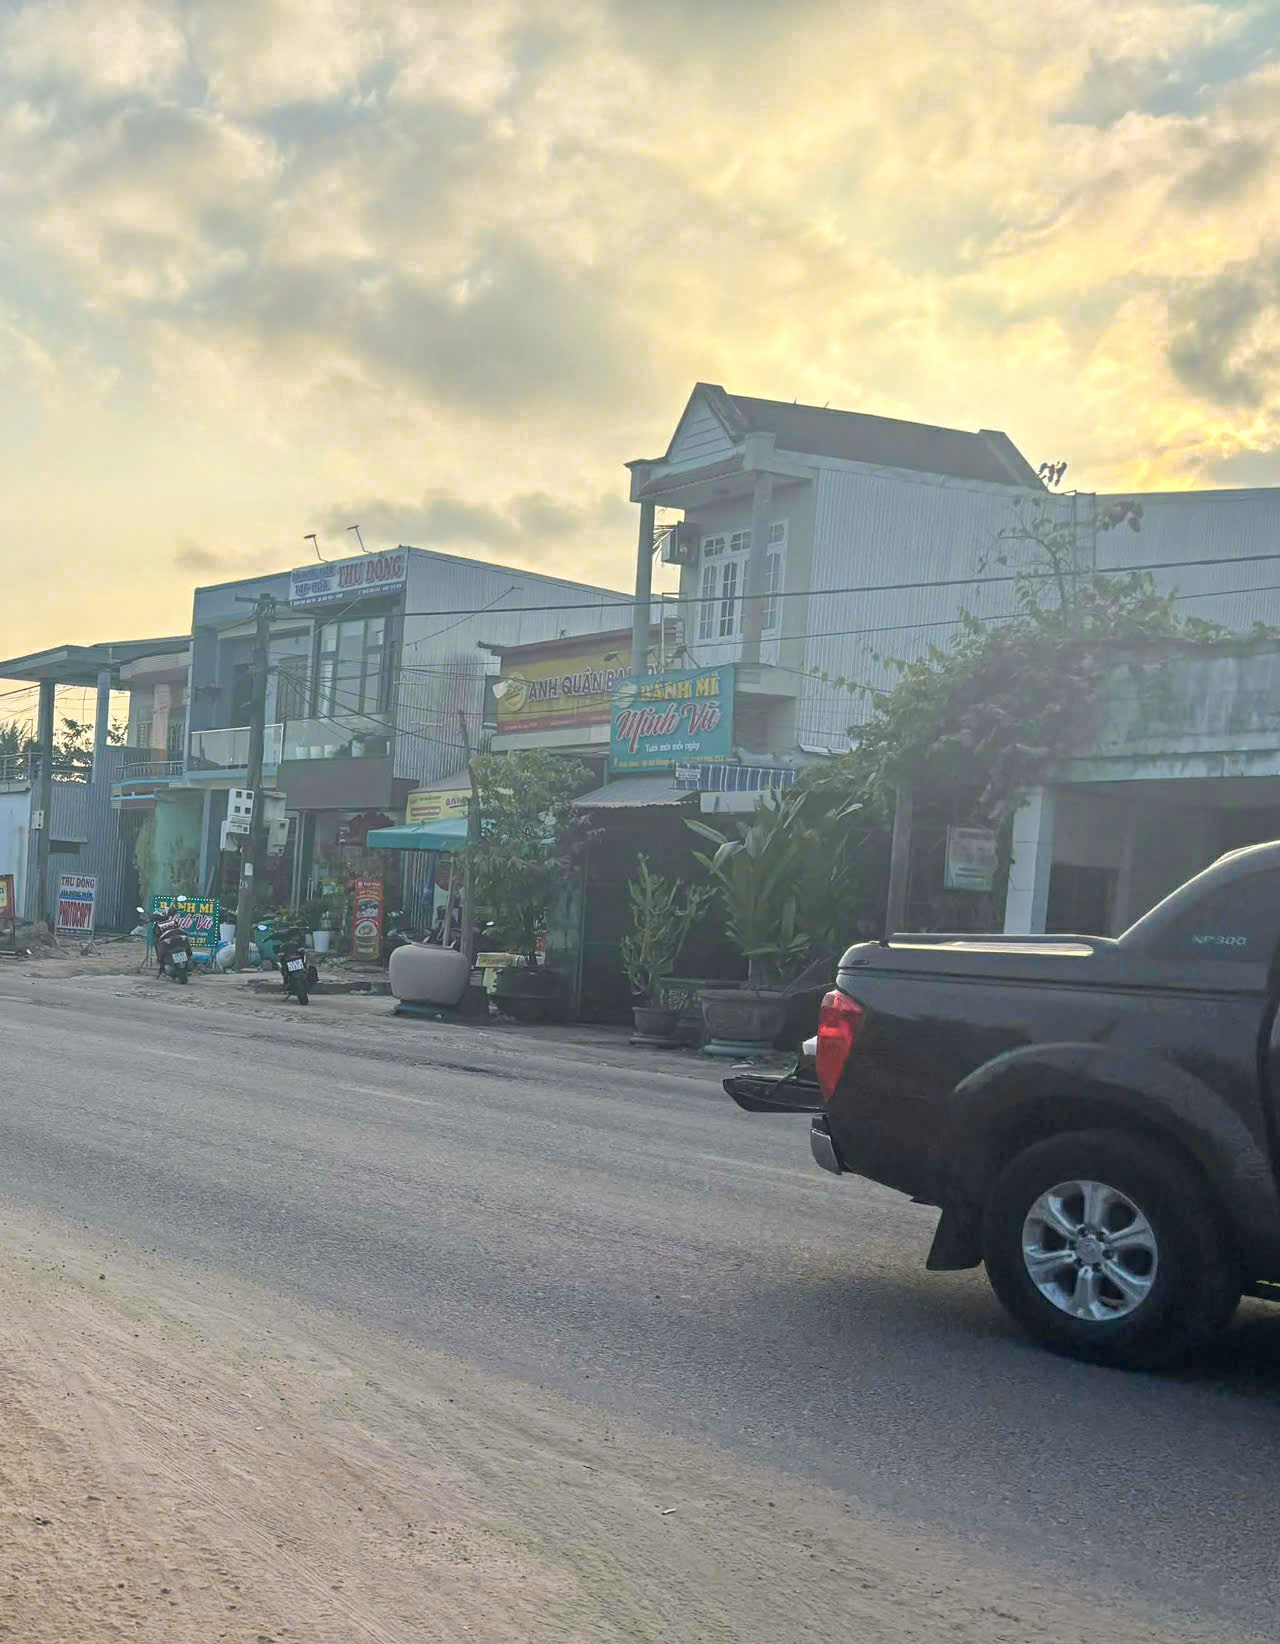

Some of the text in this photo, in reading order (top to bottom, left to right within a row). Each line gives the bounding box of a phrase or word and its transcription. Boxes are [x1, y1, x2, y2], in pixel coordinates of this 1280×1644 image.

[527, 676, 560, 701] ANH
[561, 665, 604, 698] QUÂN
[639, 671, 721, 701] BÁNH MÌ
[616, 700, 721, 753] Minh Vũ
